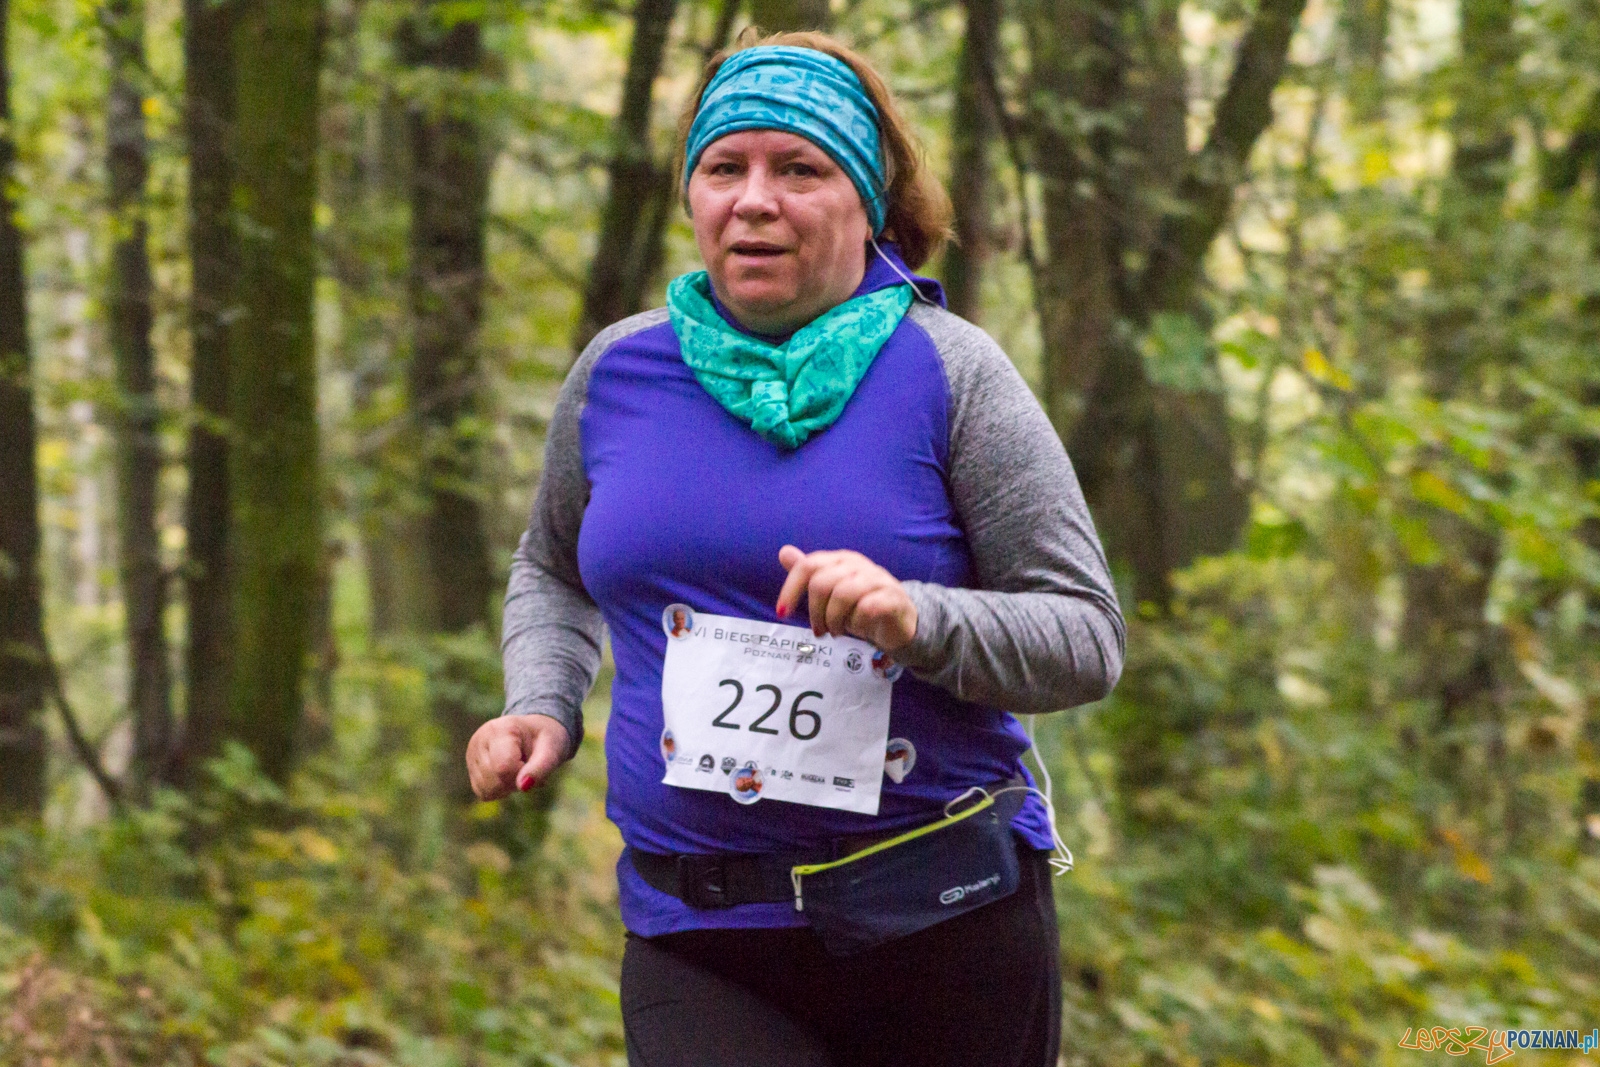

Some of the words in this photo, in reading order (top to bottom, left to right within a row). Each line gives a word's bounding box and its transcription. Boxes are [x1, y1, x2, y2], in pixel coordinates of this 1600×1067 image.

[714, 628, 750, 643] BIEG
[796, 654, 831, 668] 2016
[711, 678, 824, 741] 226
